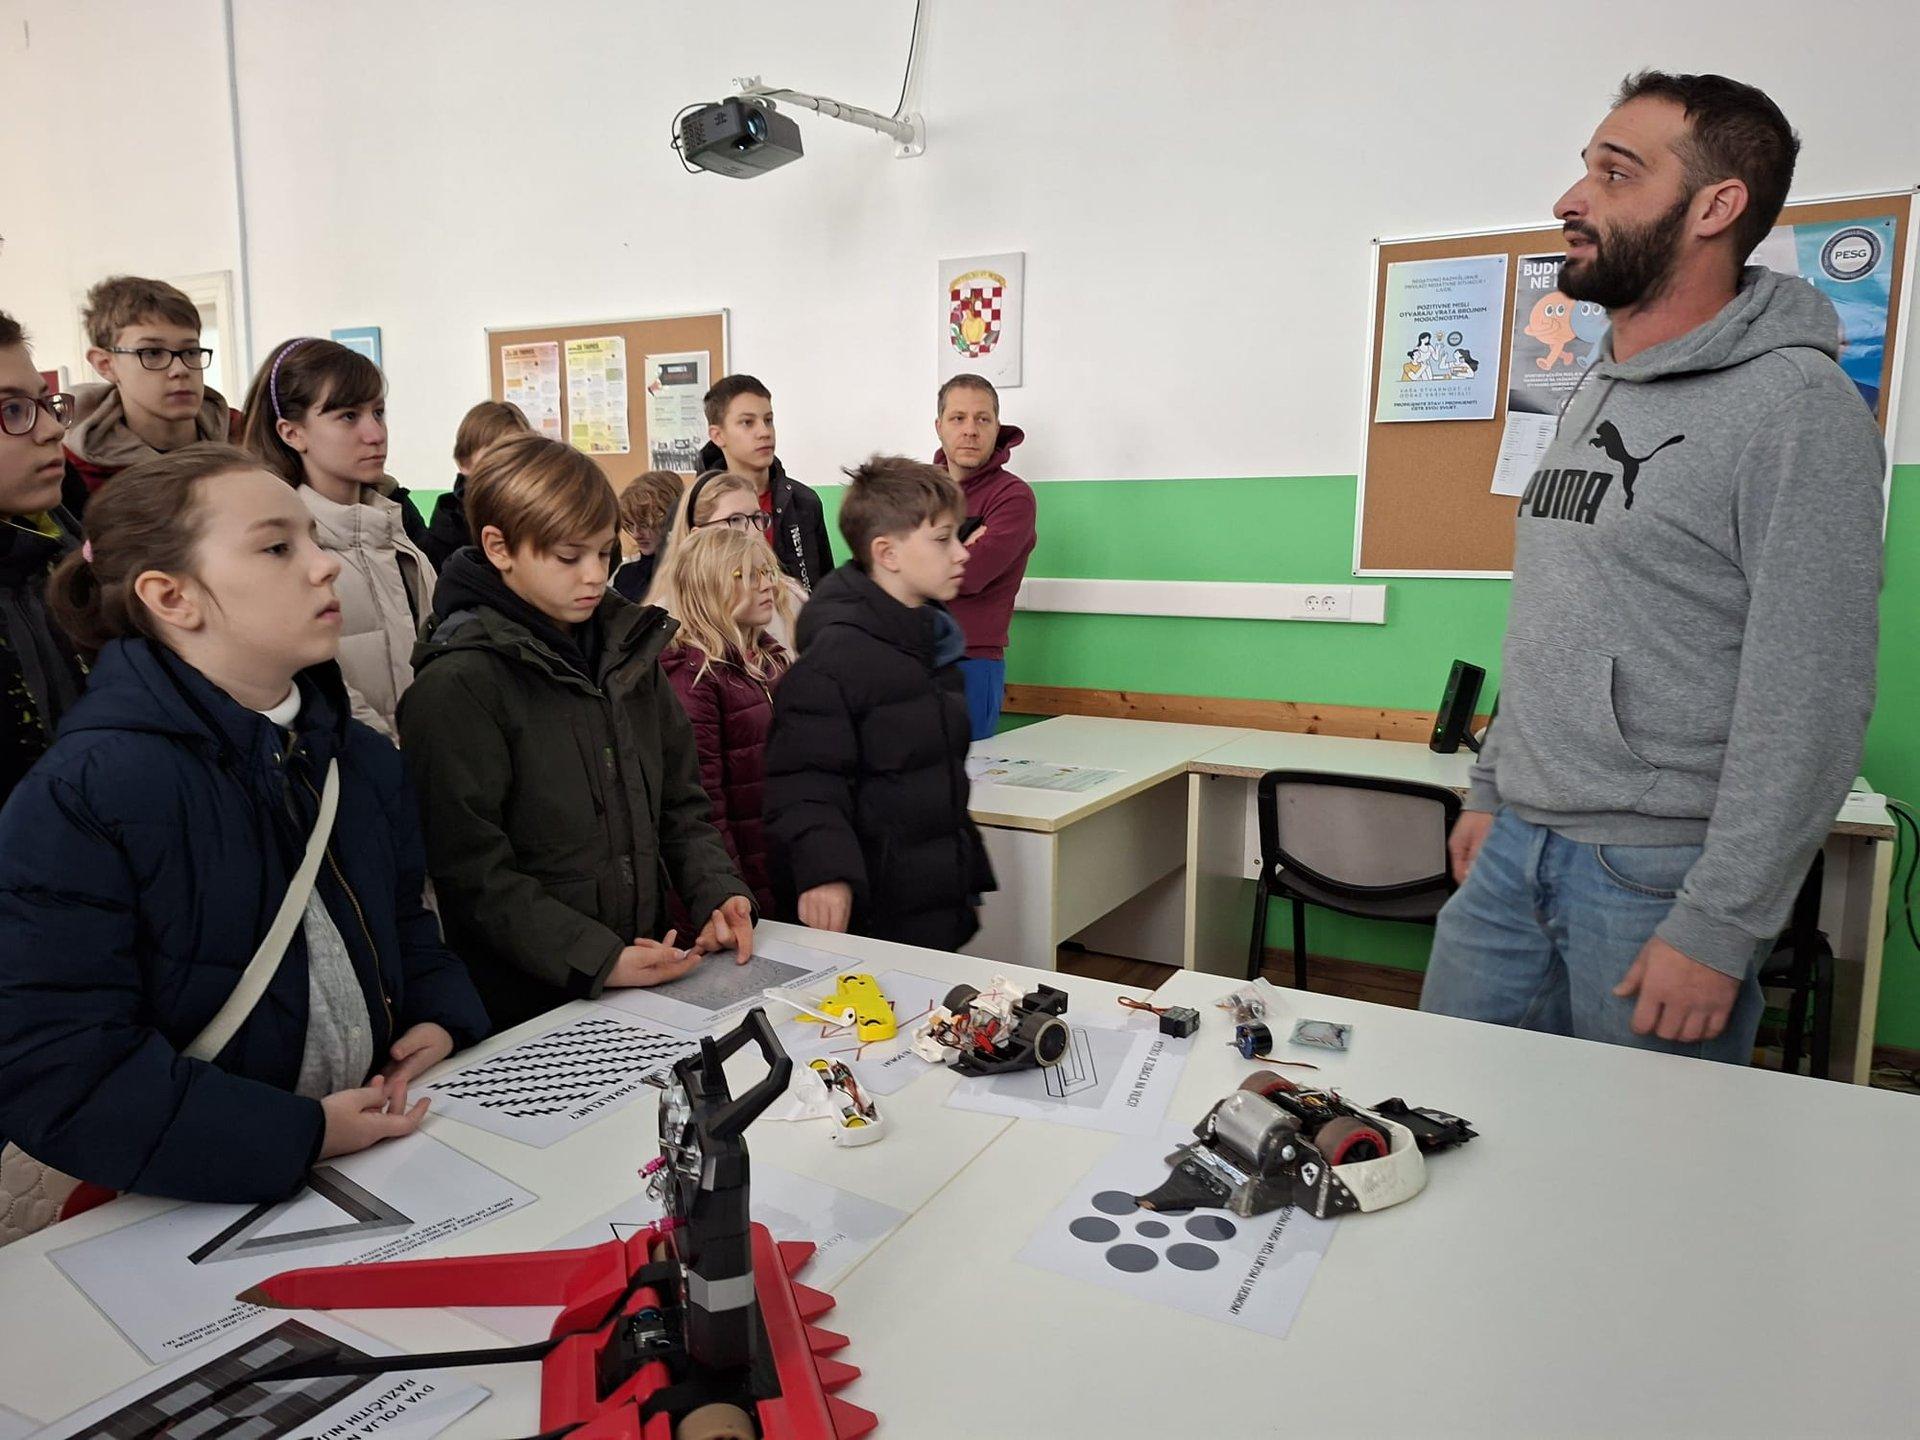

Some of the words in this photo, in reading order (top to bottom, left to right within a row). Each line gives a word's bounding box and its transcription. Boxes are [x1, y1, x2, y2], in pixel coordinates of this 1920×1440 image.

[1835, 249, 1867, 260] PESG
[1523, 262, 1559, 276] BUDI
[1530, 276, 1550, 289] NE
[1399, 310, 1433, 318] OTVARAJU
[1457, 306, 1487, 314] BROJNIM
[1518, 469, 1613, 525] PUMA
[345, 1379, 416, 1426] RAZLIČITIH
[404, 1384, 435, 1404] DVA
[361, 1404, 406, 1433] POLJA
